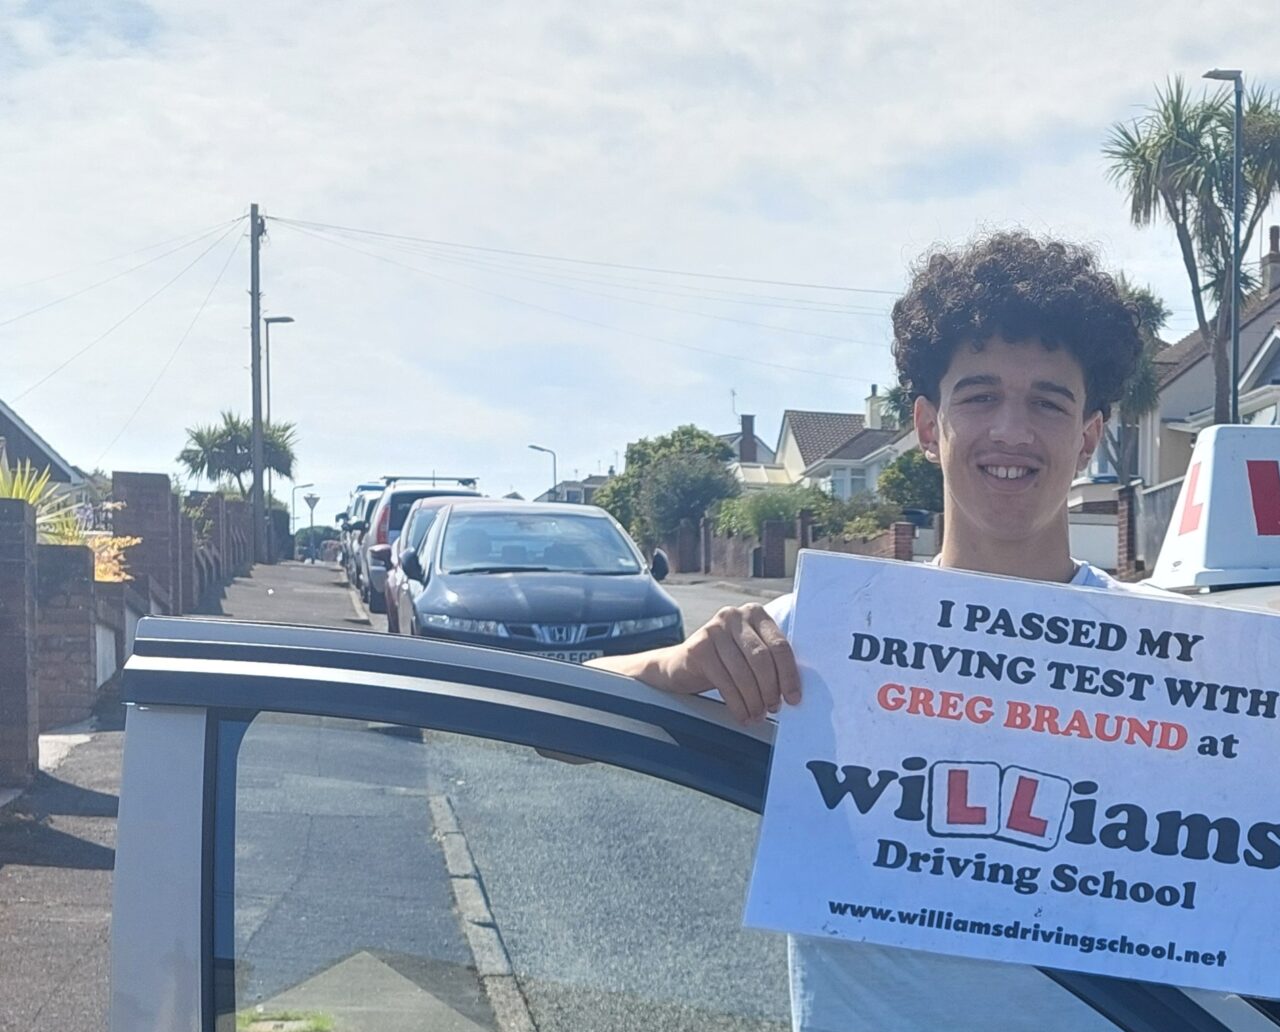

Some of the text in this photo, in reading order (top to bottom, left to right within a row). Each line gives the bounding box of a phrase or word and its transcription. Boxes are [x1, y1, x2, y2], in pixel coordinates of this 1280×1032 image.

[937, 600, 1204, 662] I PASSED MY
[849, 632, 1280, 719] DRIVING TEST WITH
[877, 683, 1239, 758] GREG BRAUND at
[873, 840, 1197, 910] Driving School
[828, 901, 1227, 968] www.williamsdrivingschool.net
